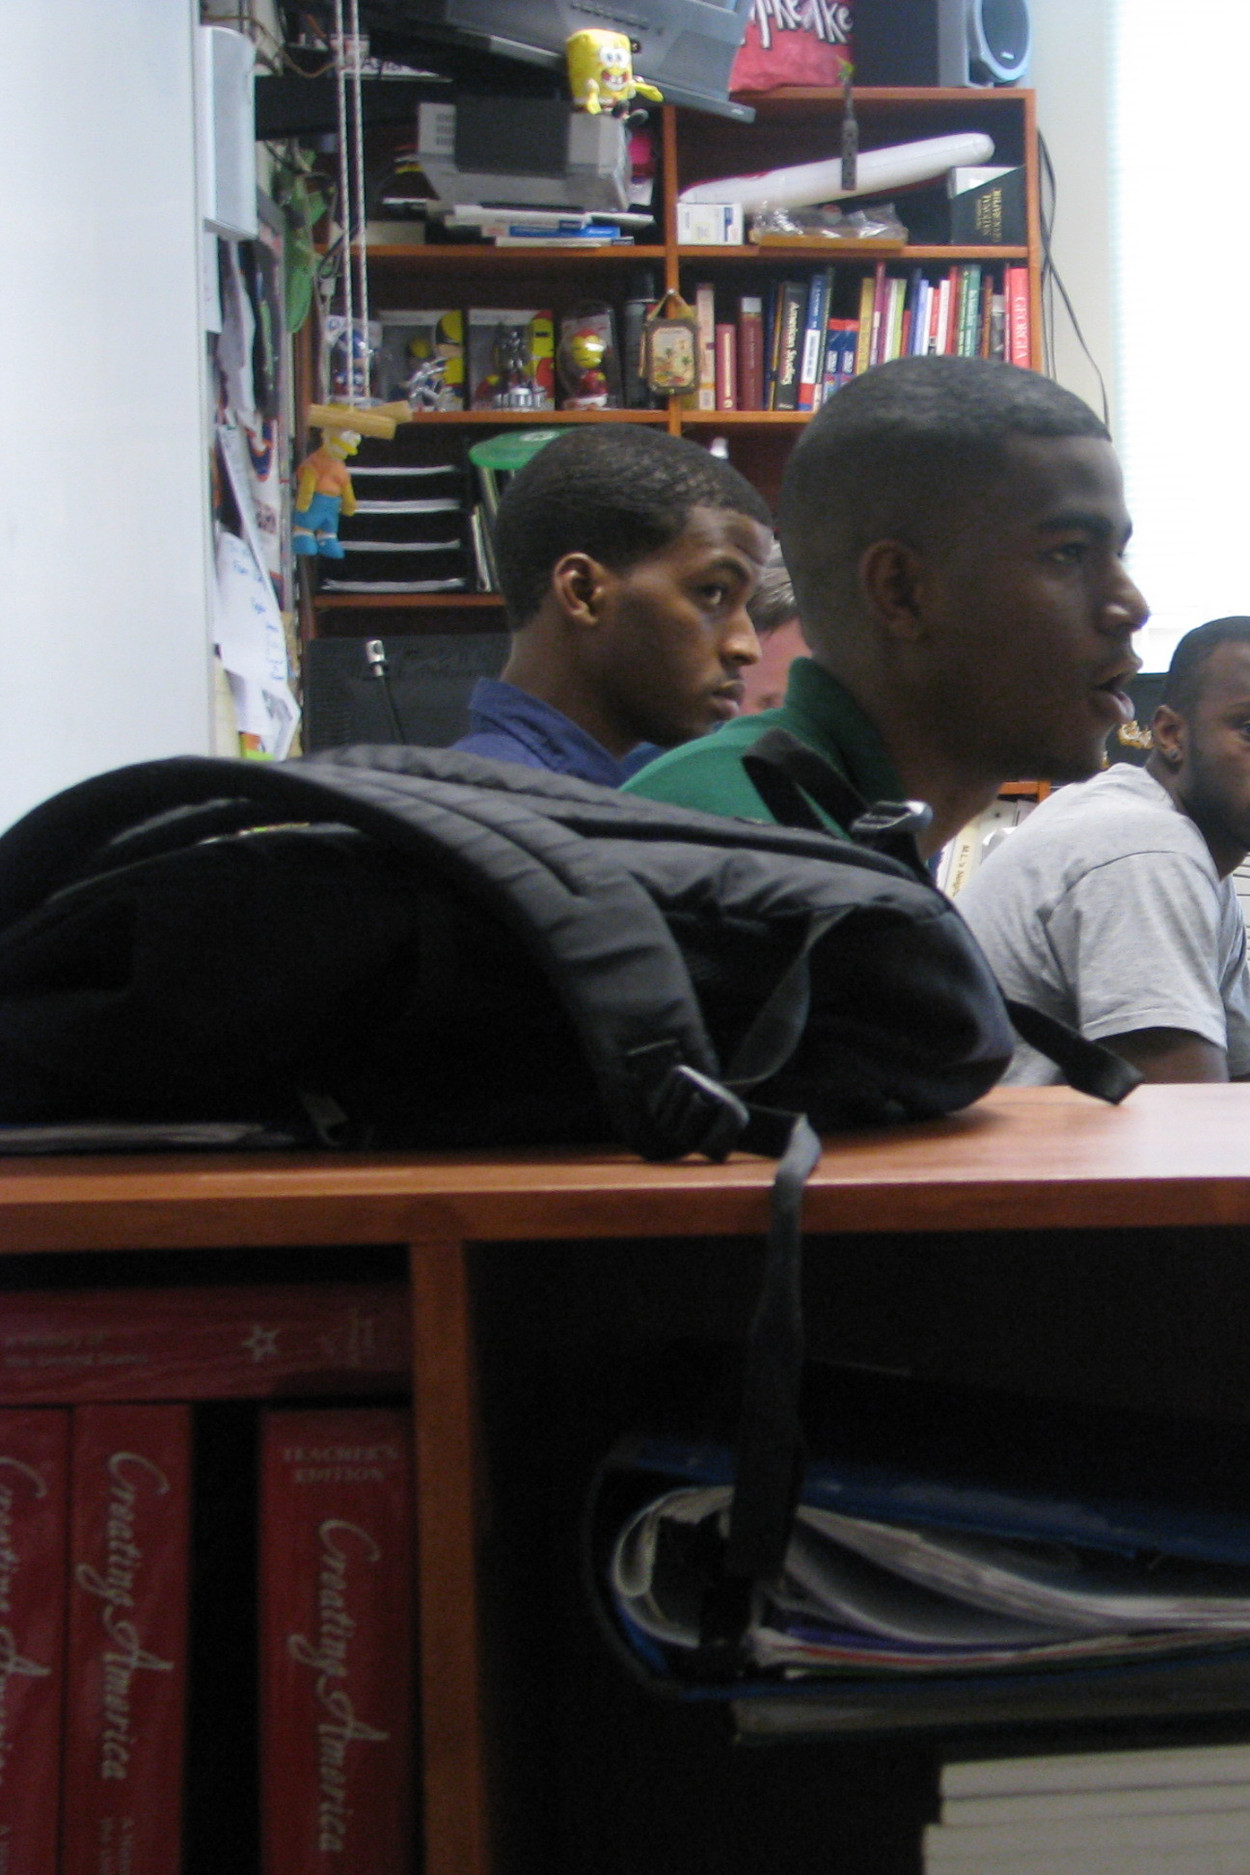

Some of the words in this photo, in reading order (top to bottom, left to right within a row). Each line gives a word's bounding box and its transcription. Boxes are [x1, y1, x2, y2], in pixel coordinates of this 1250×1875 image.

[787, 302, 800, 348] American
[1015, 296, 1029, 359] GEORGIA
[780, 349, 798, 385] Studies
[282, 1445, 399, 1462] TEACHER'S
[294, 1466, 385, 1483] EDITION
[76, 1452, 170, 1607] Creating
[287, 1520, 381, 1678] Creating
[101, 1604, 174, 1781] America
[315, 1674, 390, 1853] America
